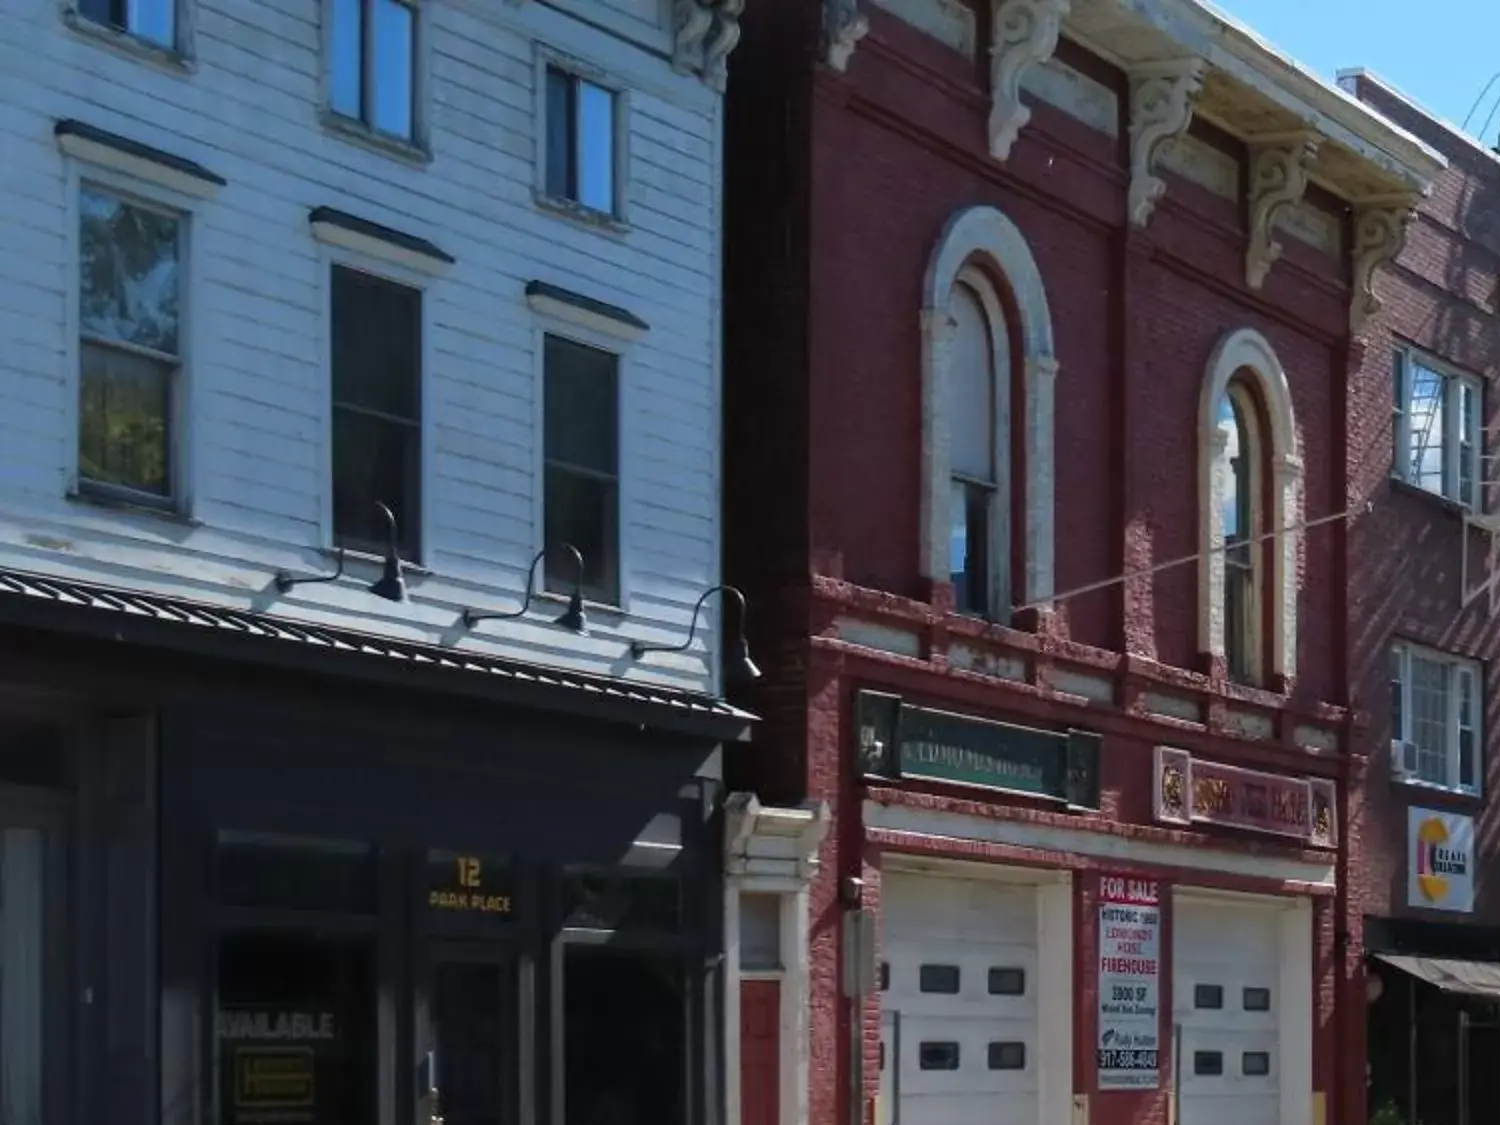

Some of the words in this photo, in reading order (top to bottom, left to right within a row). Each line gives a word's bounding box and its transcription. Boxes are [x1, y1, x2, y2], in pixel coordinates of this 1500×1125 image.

[458, 857, 481, 887] 12
[1100, 877, 1125, 898] FOR
[1128, 880, 1158, 902] SALE
[429, 891, 467, 907] PARK
[471, 895, 511, 912] PLACE
[1102, 907, 1137, 923] HISTORIC
[1102, 957, 1156, 975] FIREHOUSE
[216, 1012, 334, 1040] AVAILABLE
